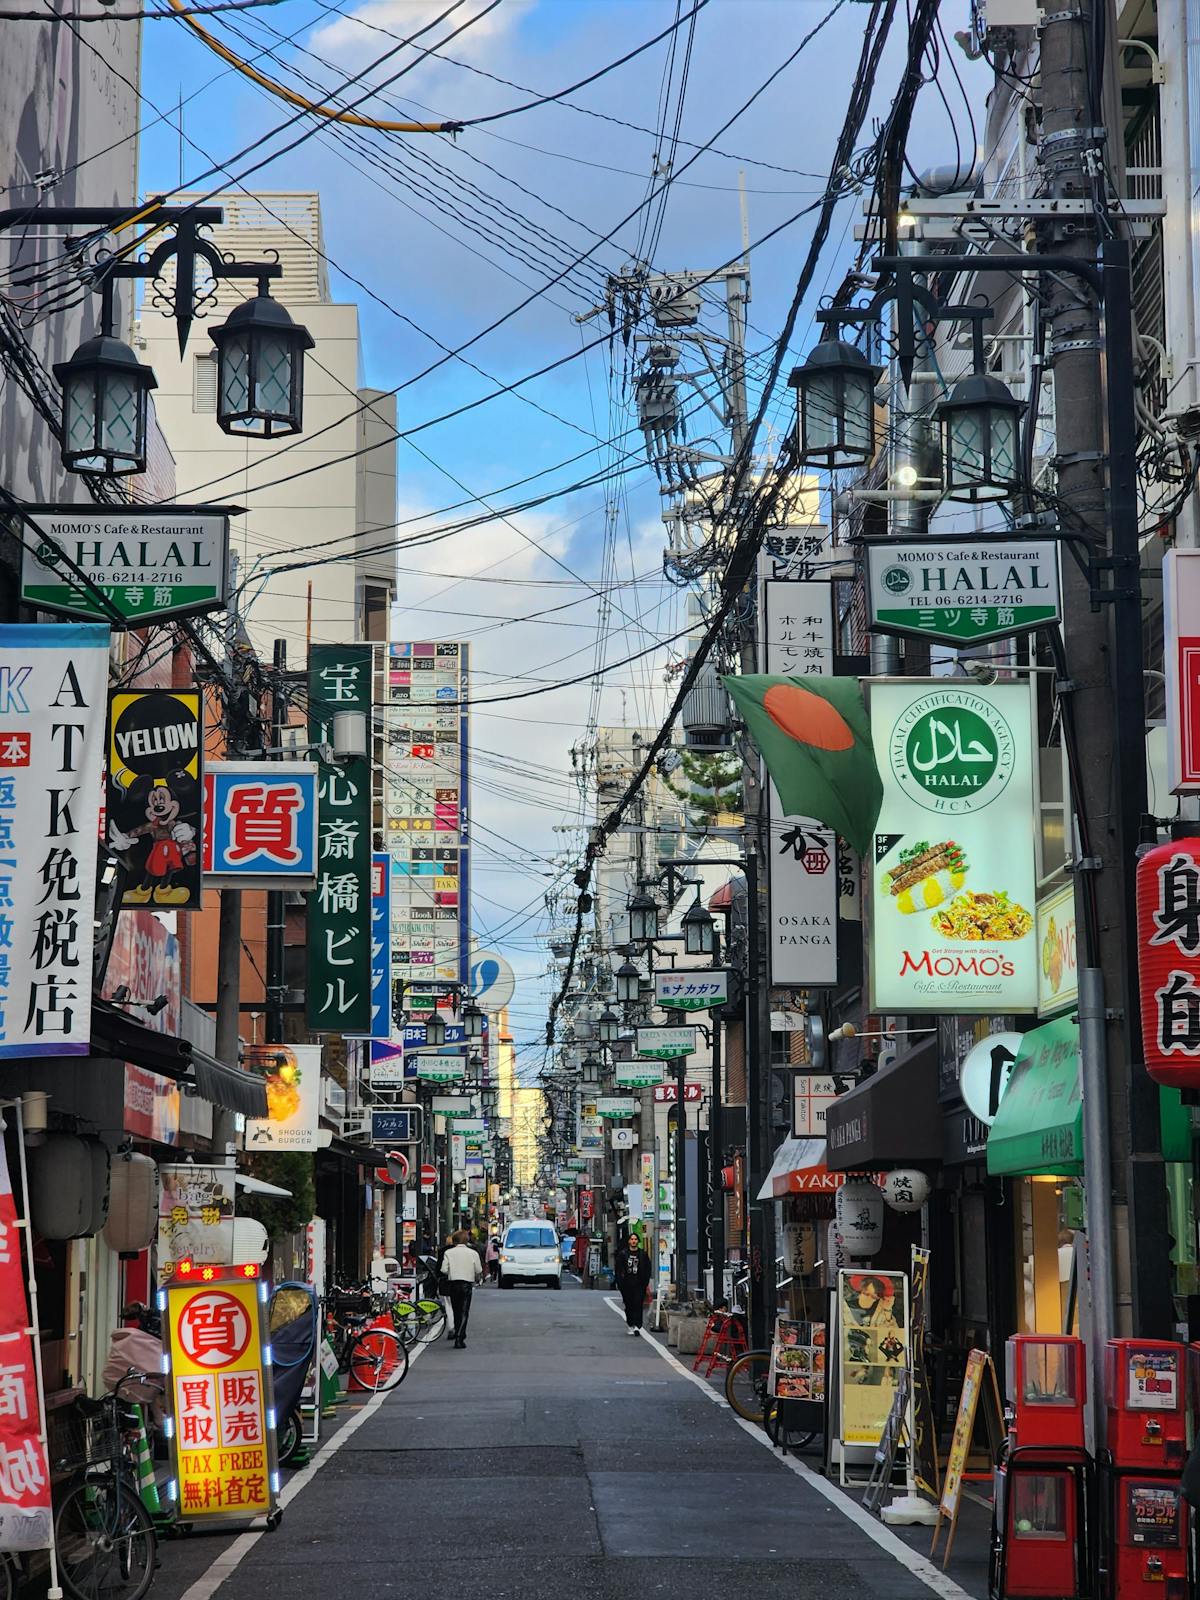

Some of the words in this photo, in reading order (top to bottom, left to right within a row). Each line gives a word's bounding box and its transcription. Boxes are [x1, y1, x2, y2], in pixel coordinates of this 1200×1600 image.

[104, 524, 128, 534] Cafe
[131, 525, 140, 534] &
[142, 525, 204, 535] Restaurant
[75, 541, 211, 567] HALAL
[946, 551, 969, 561] Cafe
[972, 551, 980, 560] &
[981, 551, 1039, 560] Restaurant
[921, 565, 1049, 591] HALAL
[908, 596, 931, 606] TEL
[935, 594, 1023, 606] 06-6214-2716
[918, 607, 1015, 628] 三ツ寺筋
[779, 616, 798, 673] ホルモン
[802, 615, 825, 674] 和牛焼肉
[115, 721, 198, 759] YELLOW
[893, 728, 908, 769] HALAL
[905, 694, 993, 724] CERTIFICATION
[992, 719, 1012, 770] AGENCY
[913, 716, 993, 772] حلال
[925, 774, 982, 786] HALAL
[226, 785, 303, 863] 質
[317, 663, 361, 1015] 宝心斎橋ビル
[877, 835, 888, 844] 3F
[877, 845, 888, 854] 2F
[779, 916, 832, 926] OSAKA
[779, 935, 832, 945] PANGA
[913, 980, 934, 993] Cafe
[937, 980, 949, 991] &
[949, 979, 1002, 991] Restaurant
[893, 1176, 913, 1203] 焼肉
[171, 1206, 220, 1226] 免税
[187, 1302, 239, 1358] 質
[182, 1379, 215, 1444] 買取
[223, 1375, 259, 1444] 販売
[182, 1455, 212, 1474] TAX
[219, 1450, 264, 1471] FREE
[183, 1474, 266, 1509] 無料査定
